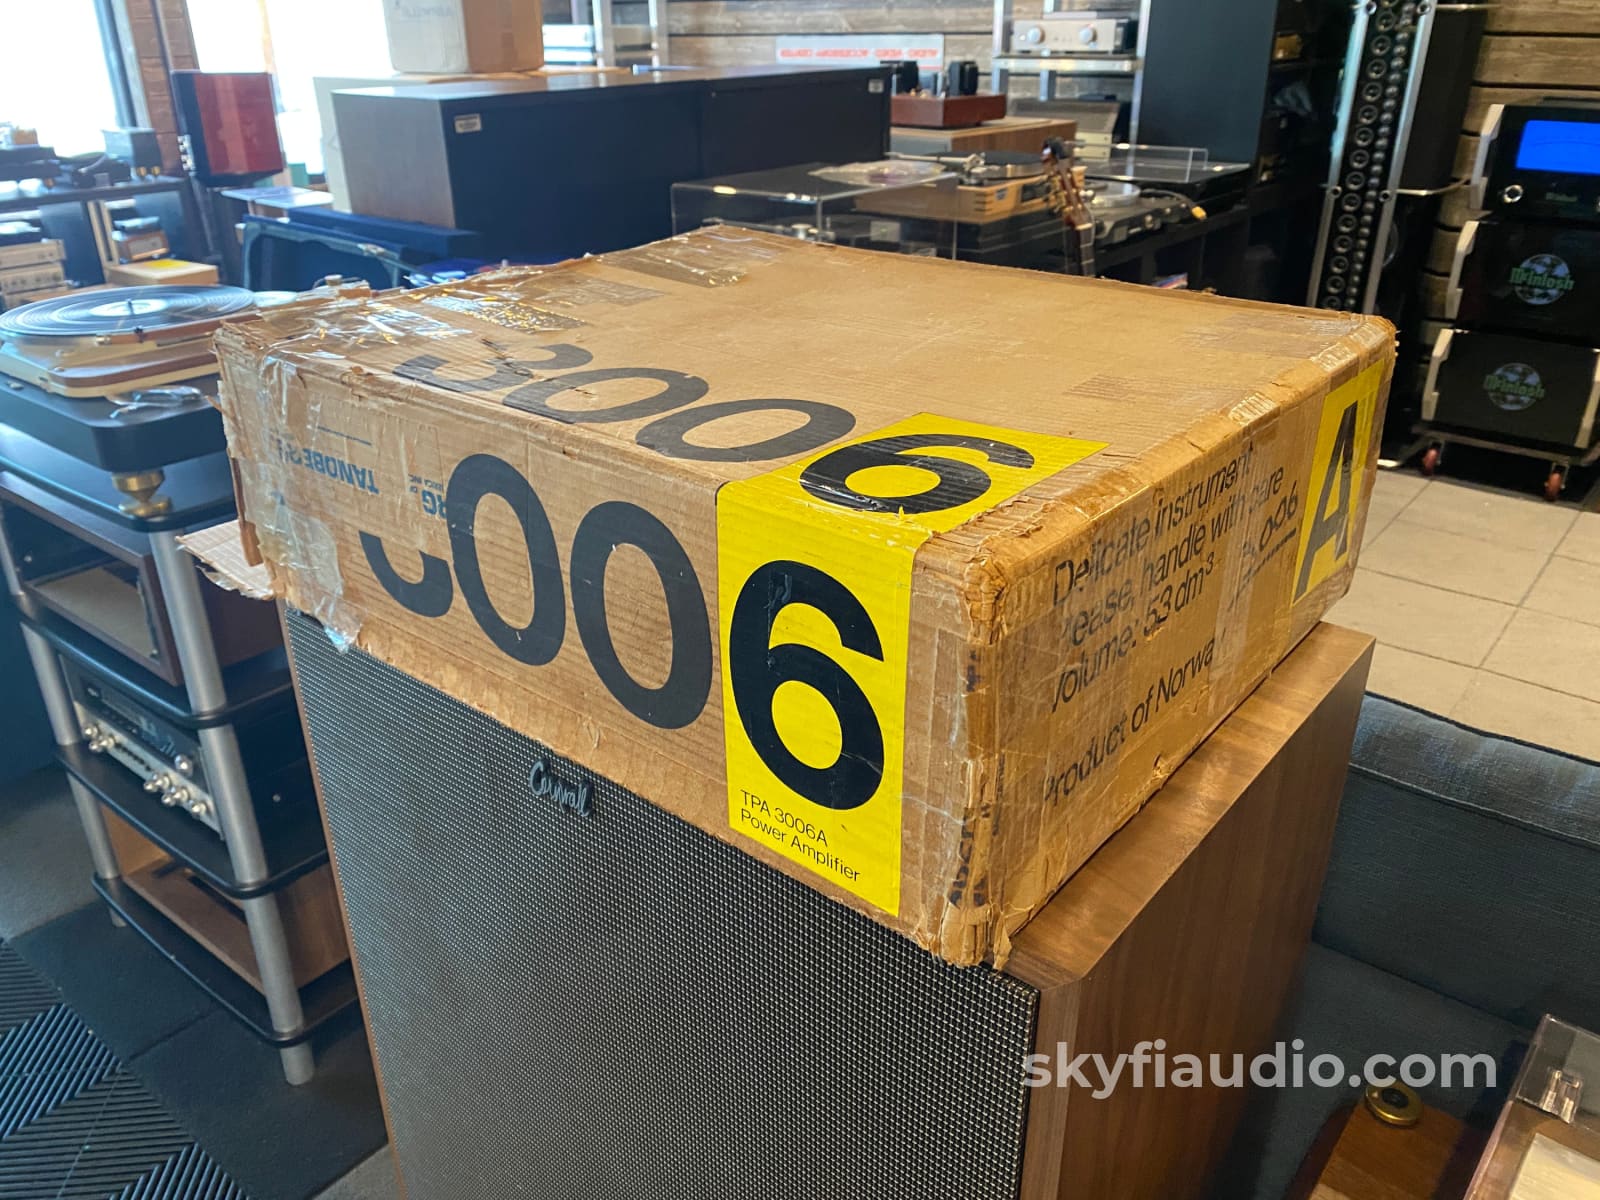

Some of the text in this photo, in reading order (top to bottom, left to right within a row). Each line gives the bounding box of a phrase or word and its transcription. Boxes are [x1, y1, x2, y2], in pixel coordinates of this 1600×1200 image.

[1053, 444, 1254, 607] Delicate instrument
[1140, 523, 1206, 596] handle
[1211, 494, 1246, 543] with
[1293, 401, 1358, 604] A
[1131, 685, 1154, 733] of
[1155, 630, 1224, 713] Norwa
[740, 789, 828, 847] TPA 3006A
[740, 808, 861, 881] Power Amplifier
